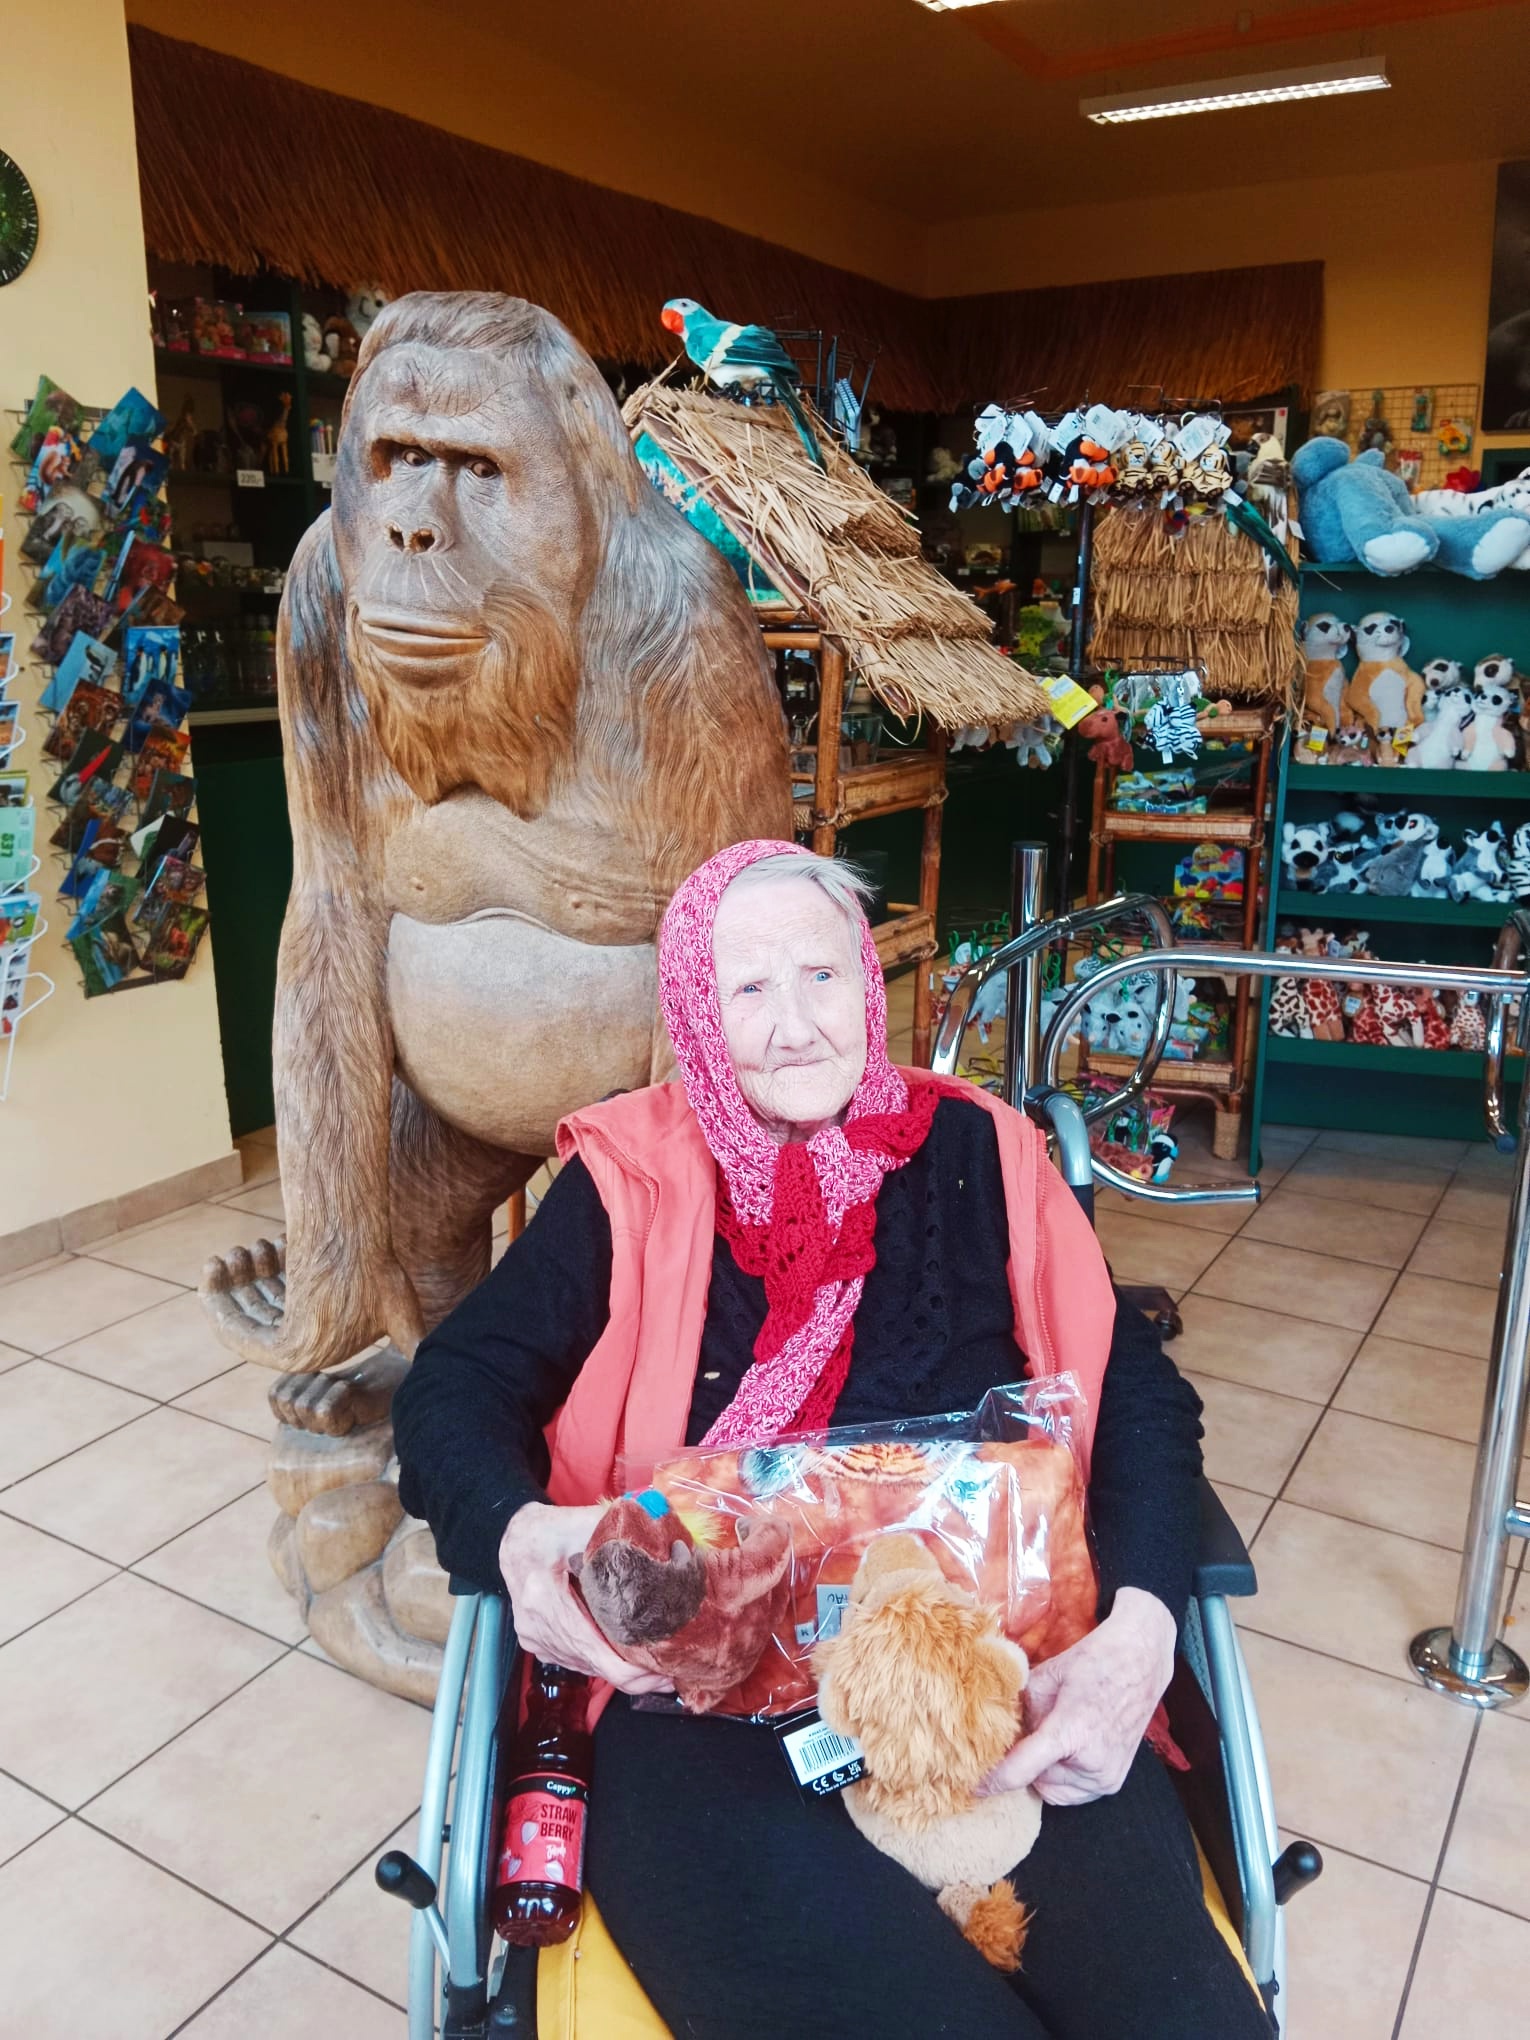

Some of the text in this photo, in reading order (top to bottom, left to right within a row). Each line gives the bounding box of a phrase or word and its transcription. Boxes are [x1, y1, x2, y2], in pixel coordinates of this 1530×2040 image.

[546, 1780, 572, 1796] Cappy
[812, 1775, 830, 1792] CE
[541, 1803, 577, 1825] STRAW
[540, 1822, 574, 1842] BERRY
